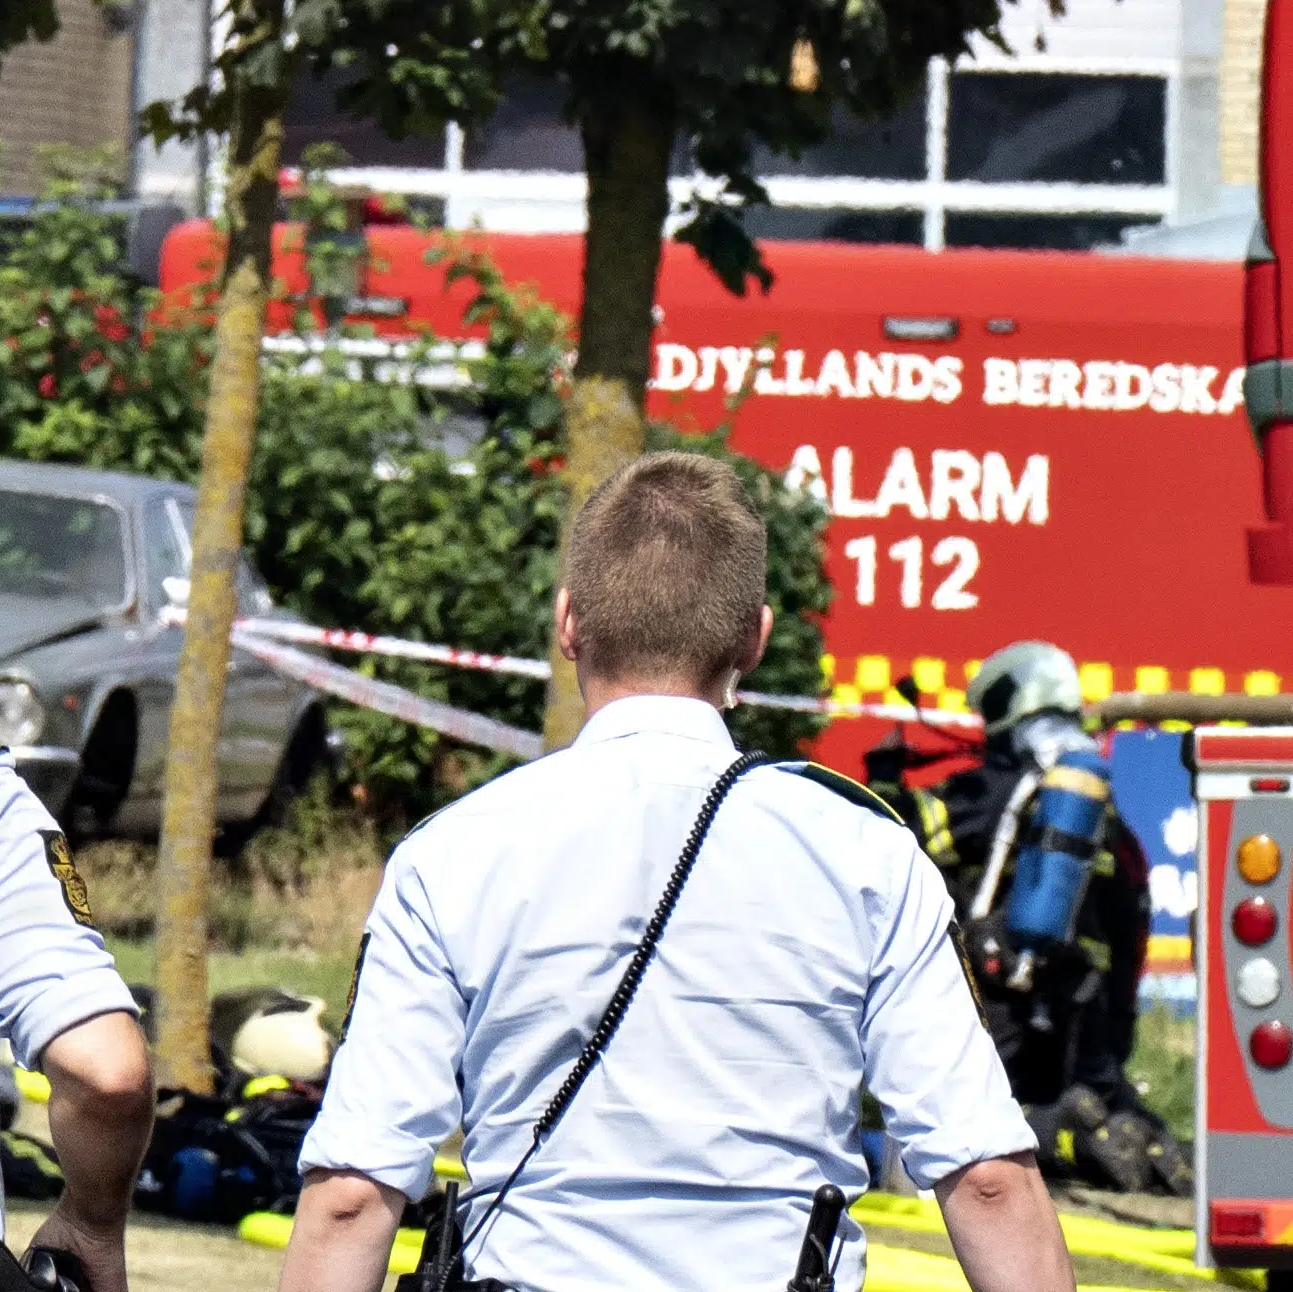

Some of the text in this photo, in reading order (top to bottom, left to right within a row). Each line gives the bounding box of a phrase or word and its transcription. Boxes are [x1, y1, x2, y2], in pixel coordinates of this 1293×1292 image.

[647, 343, 1247, 415] DJYLLANDS BEREDSKA
[783, 444, 1050, 525] ALARM
[844, 535, 981, 610] 112
